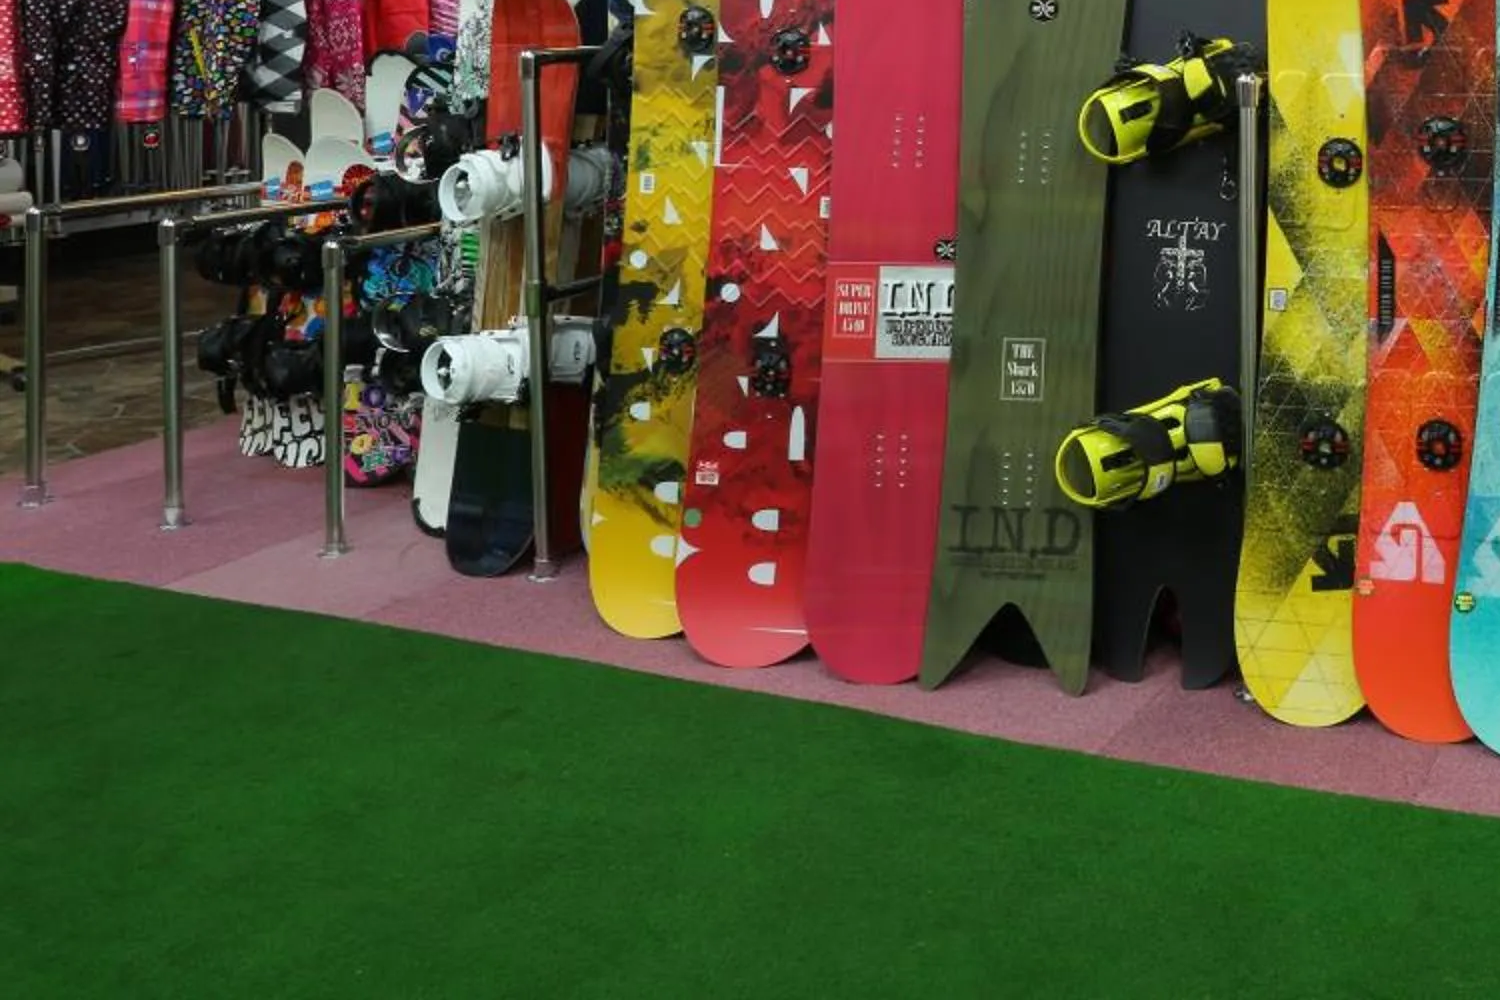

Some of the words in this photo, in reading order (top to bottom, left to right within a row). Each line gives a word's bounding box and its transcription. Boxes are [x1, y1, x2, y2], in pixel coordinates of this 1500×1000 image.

[1146, 217, 1227, 241] ALTAY
[838, 283, 871, 298] SUPER
[838, 301, 869, 315] DRIVE
[1011, 343, 1035, 359] THE
[1007, 361, 1039, 377] Shark
